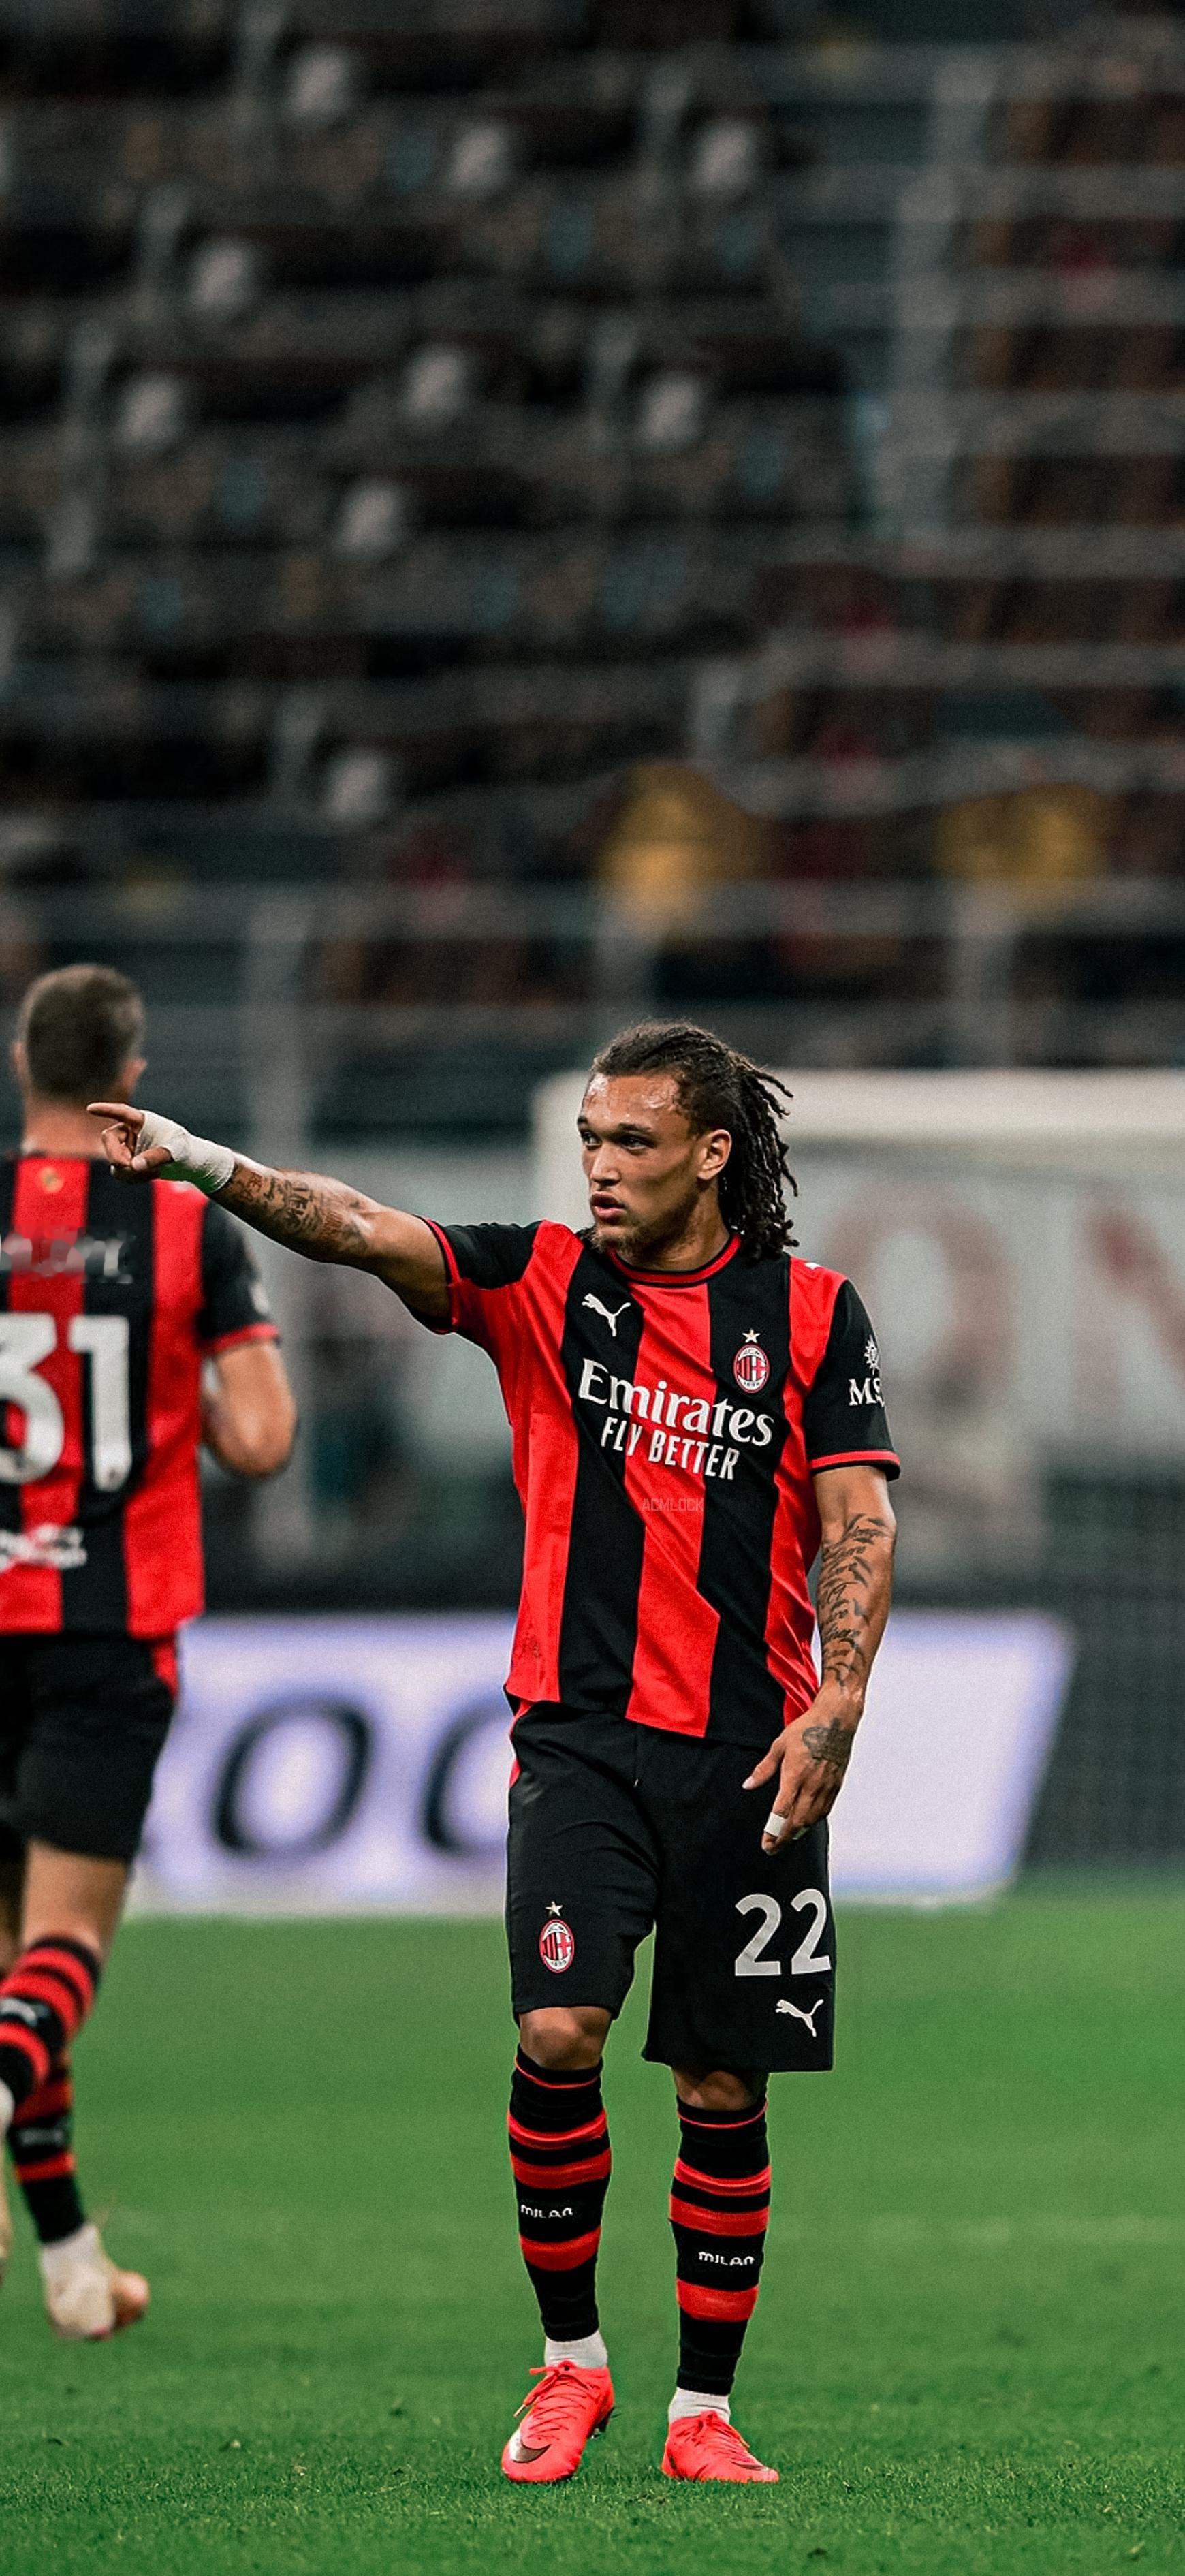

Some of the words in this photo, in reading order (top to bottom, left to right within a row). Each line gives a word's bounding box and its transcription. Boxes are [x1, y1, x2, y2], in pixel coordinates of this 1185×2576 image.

[0, 1311, 132, 1492] 31
[578, 1357, 775, 1447] Emirates
[600, 1416, 643, 1457] FLY
[648, 1429, 740, 1481] BETTER
[735, 1889, 832, 1977] 22
